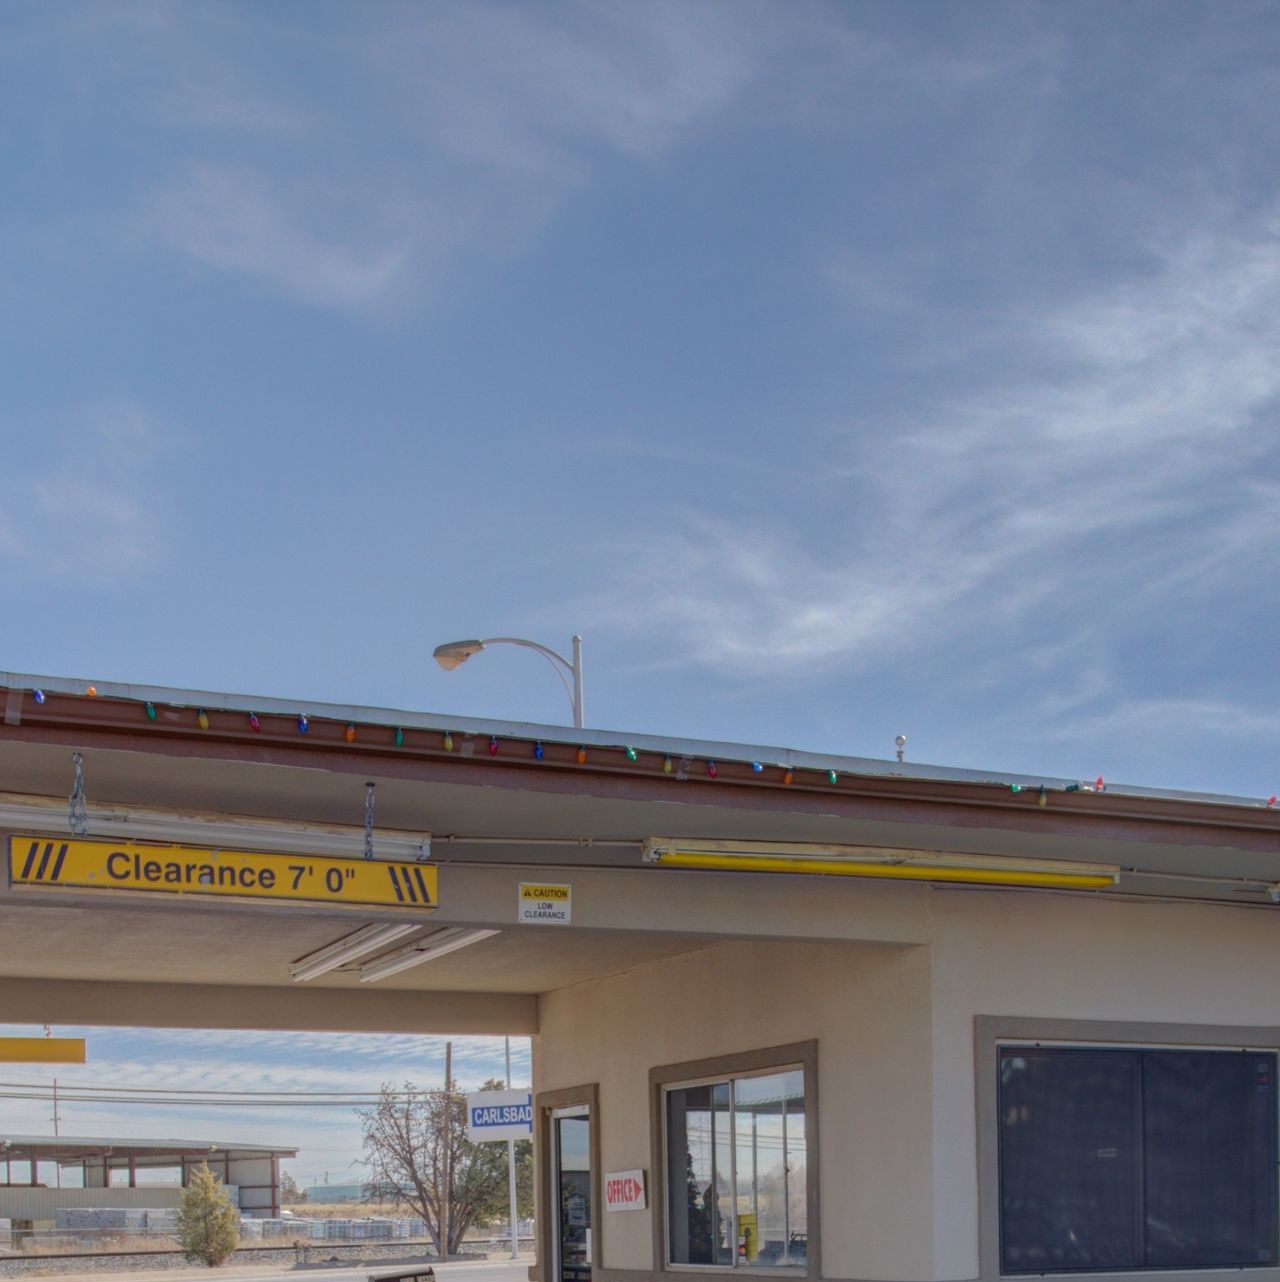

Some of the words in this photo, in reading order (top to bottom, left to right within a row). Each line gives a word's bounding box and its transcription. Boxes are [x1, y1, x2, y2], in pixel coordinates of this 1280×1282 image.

[105, 851, 276, 889] Clearance
[287, 865, 314, 890] 7'
[325, 868, 356, 893] 0"
[533, 888, 568, 898] CAUTION
[537, 902, 553, 910] LOW
[524, 910, 566, 919] CLEARANCE
[474, 1106, 533, 1125] CARLSBAD
[607, 1178, 634, 1204] OFFICE
